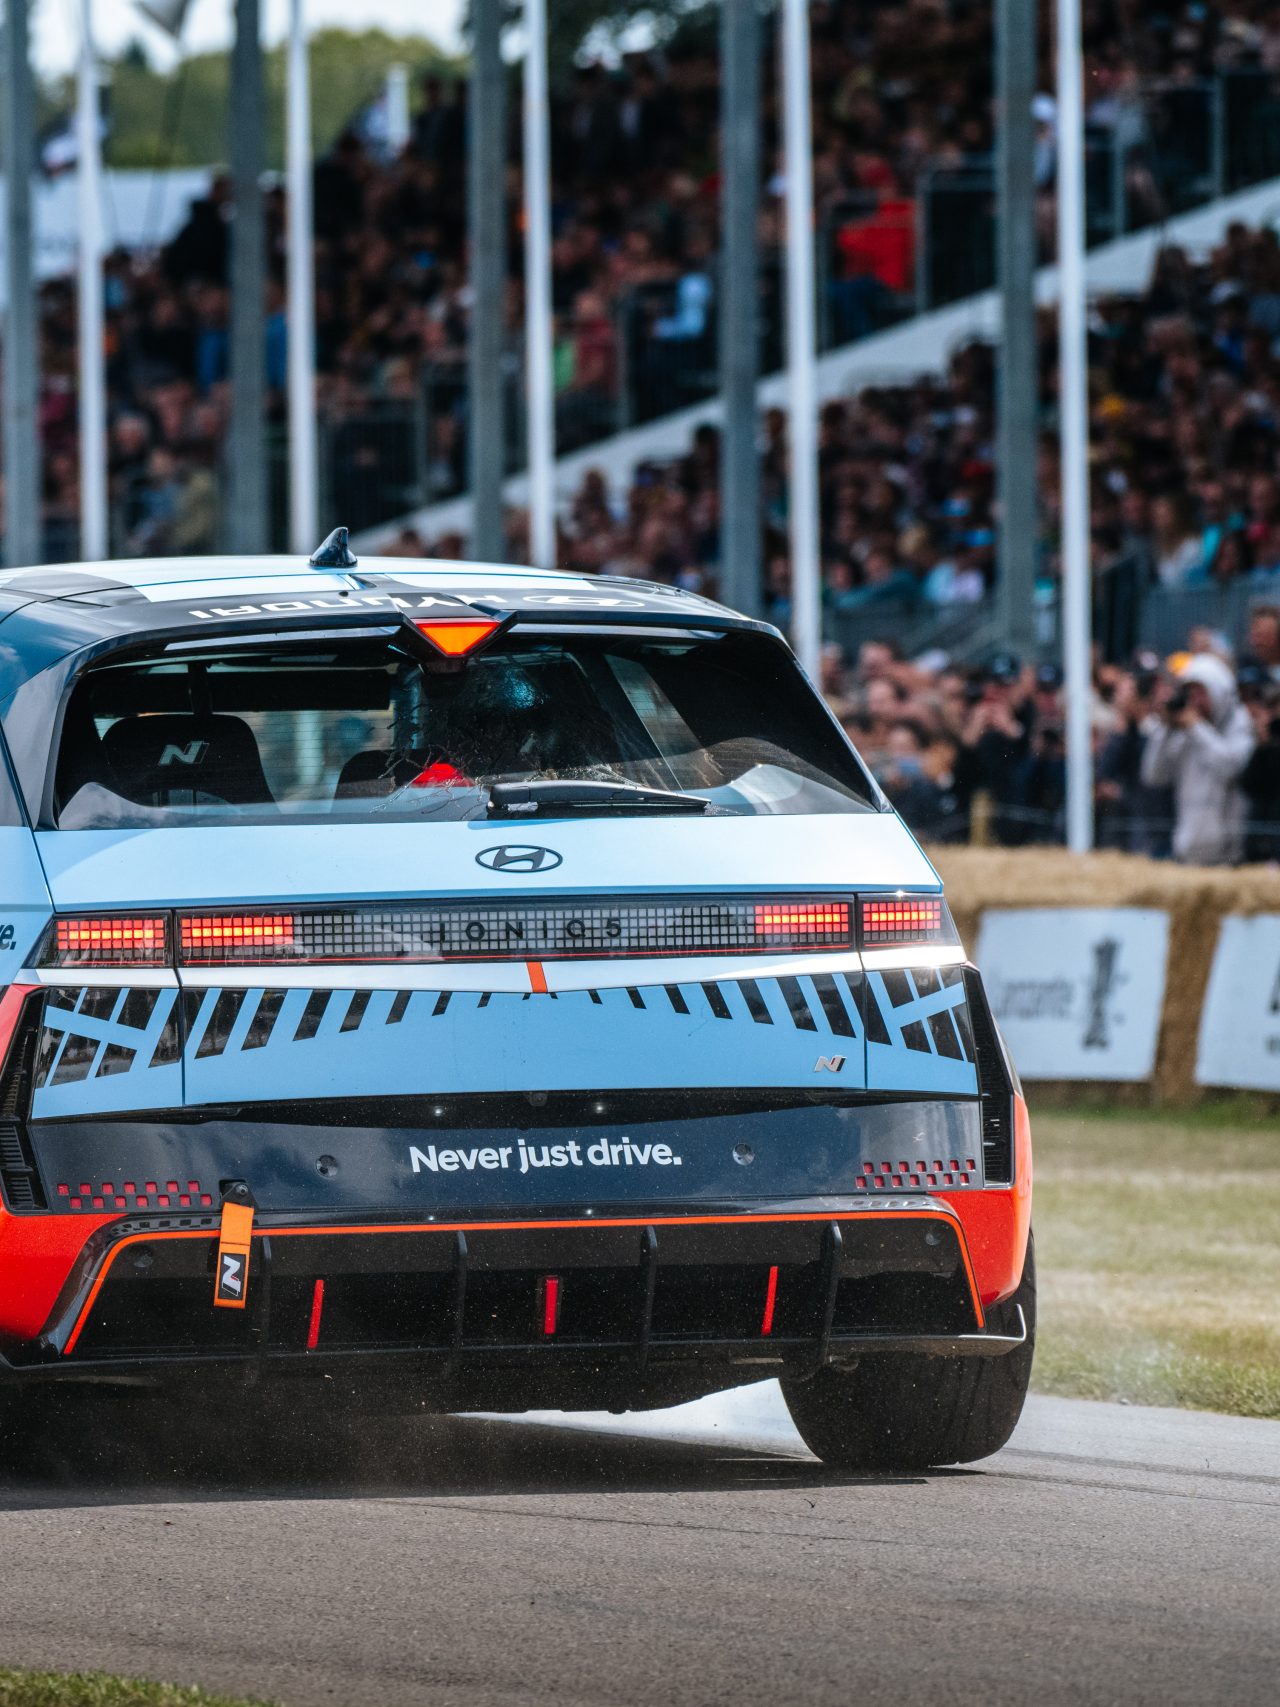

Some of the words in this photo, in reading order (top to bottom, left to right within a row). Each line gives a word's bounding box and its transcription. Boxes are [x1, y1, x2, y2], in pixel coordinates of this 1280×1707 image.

[190, 595, 506, 618] HYUNDAI
[438, 920, 586, 943] IONIQ
[606, 918, 622, 938] 5
[814, 1055, 847, 1073] N
[409, 1145, 513, 1173] Never
[517, 1138, 583, 1174] just
[586, 1136, 683, 1167] drive.
